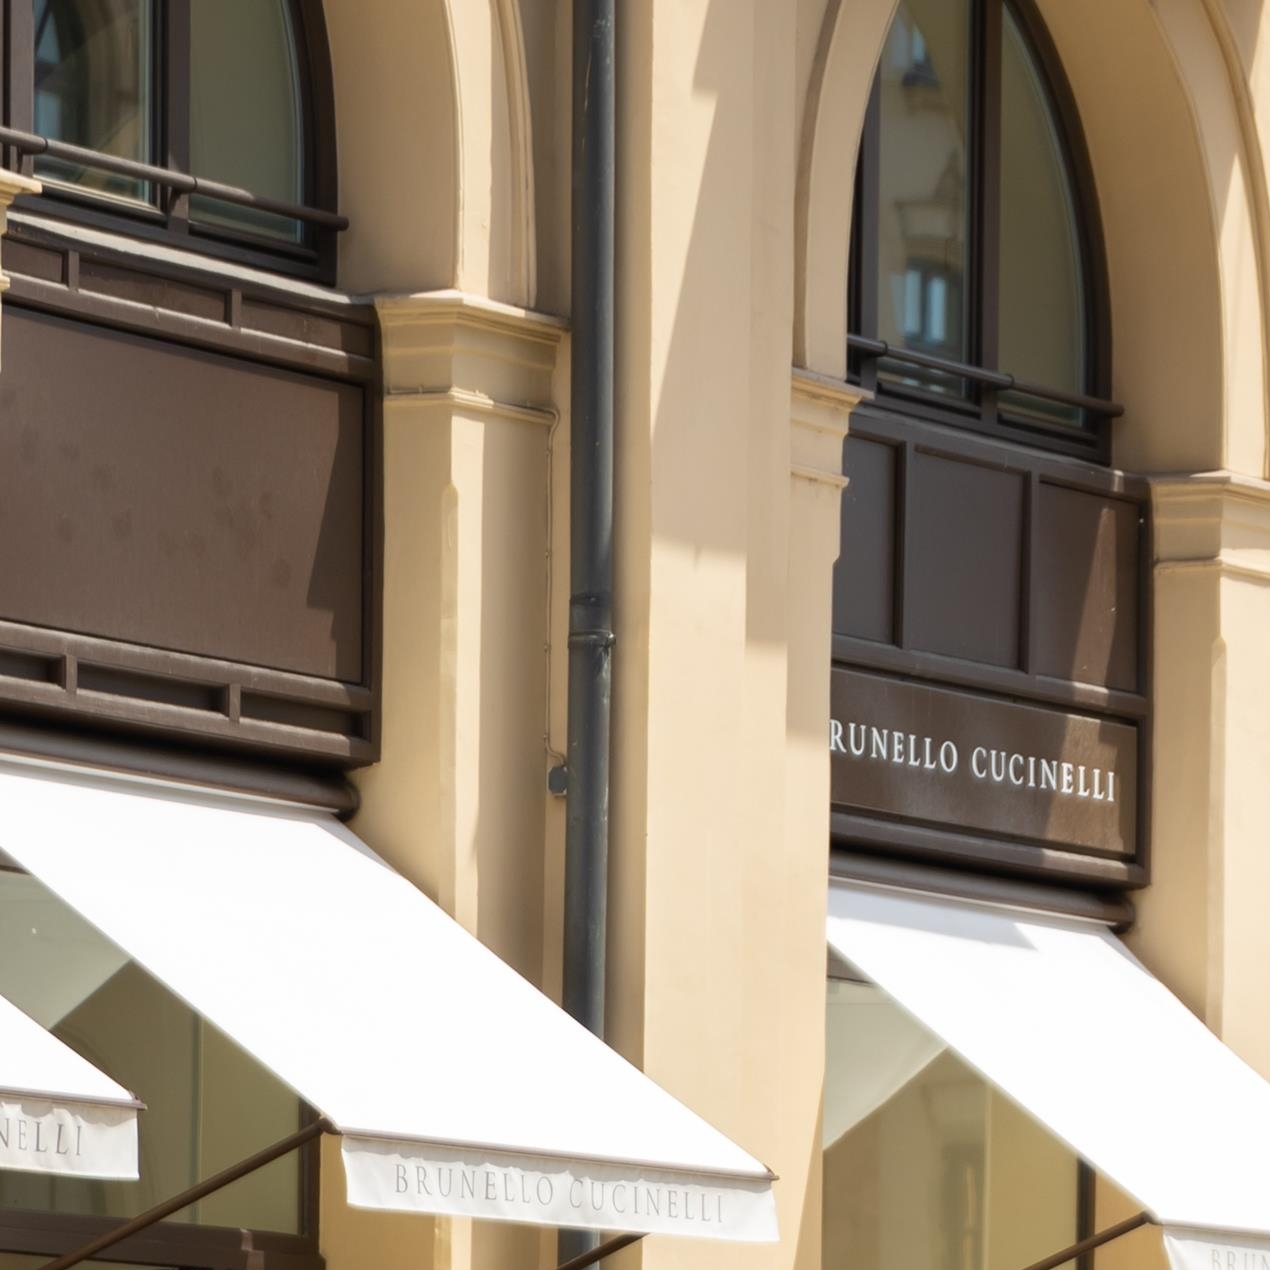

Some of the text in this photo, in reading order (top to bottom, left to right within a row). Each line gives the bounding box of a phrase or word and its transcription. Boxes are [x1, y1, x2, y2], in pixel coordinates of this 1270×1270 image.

[829, 719, 1115, 802] RUNELLO CUCINELLI
[395, 1164, 724, 1223] BRUNELLO CUCINELLI
